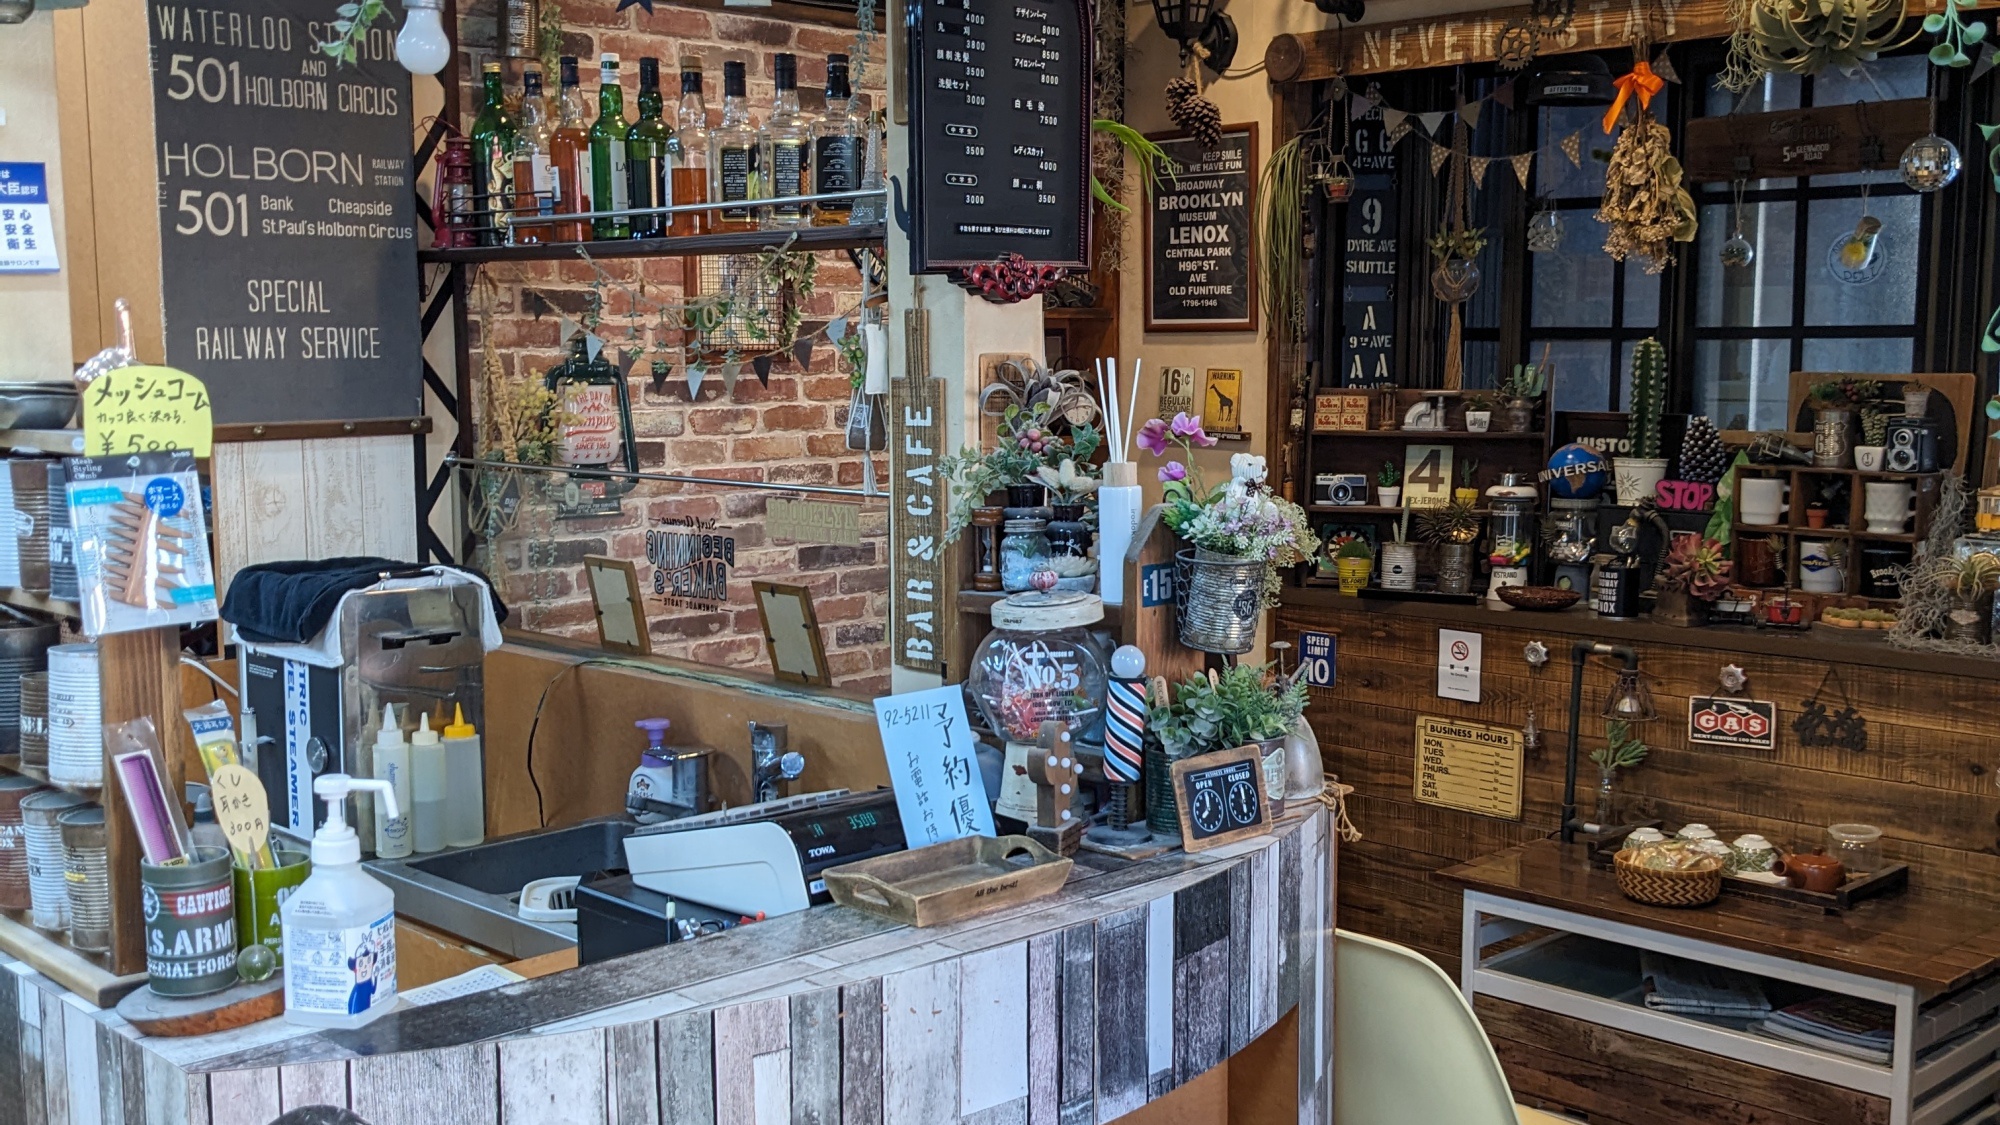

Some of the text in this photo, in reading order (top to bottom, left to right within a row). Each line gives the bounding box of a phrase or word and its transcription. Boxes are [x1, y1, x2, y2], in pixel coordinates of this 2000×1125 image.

[965, 13, 985, 25] 4000
[157, 4, 291, 52] WATERLOO
[1042, 25, 1060, 36] 8000
[966, 40, 985, 51] 3800
[1042, 50, 1060, 61] 8500
[301, 59, 327, 77] AND
[965, 66, 985, 77] 3500
[167, 54, 240, 105] 501
[245, 76, 328, 111] HOLBORN
[338, 83, 398, 115] CIRCUS
[1041, 74, 1059, 85] 8000
[966, 95, 985, 105] 3000
[1040, 115, 1058, 125] 7500
[965, 146, 985, 156] 3500
[1796, 143, 1830, 154] GLENWOOD
[1202, 152, 1220, 162] KEEP
[1221, 149, 1242, 160] SMILE
[1803, 152, 1823, 161] ROAD
[163, 141, 405, 187] HOLBORN RAILWAY STATION
[1039, 161, 1057, 172] 4000
[1189, 160, 1242, 172] WE HAVE FUN
[1371, 156, 1395, 169] AVE
[1175, 179, 1224, 191] BROADWAY
[965, 194, 985, 205] 3000
[1038, 194, 1056, 204] 3500
[1158, 191, 1244, 210] BROOKLYN
[2, 208, 32, 221] 安心
[176, 189, 248, 237] 501
[261, 195, 294, 212] Bank
[328, 199, 393, 218] Cheapside
[1178, 211, 1217, 222] MUSEUM
[1361, 198, 1382, 234] 9
[4, 223, 35, 236] 安全
[317, 221, 366, 238] Holborn
[368, 224, 413, 239] Circus
[1169, 224, 1229, 245] LENOX
[6, 238, 37, 251] 衛生
[1347, 239, 1396, 252] DYRE AVE
[1165, 247, 1232, 258] CENTRAL PARK
[1346, 260, 1396, 274] SHUTTLE
[1189, 273, 1207, 283] AVE
[247, 279, 330, 315] SPECIAL
[1168, 285, 1233, 296] OLD FUNITURE
[1362, 305, 1377, 330] A
[196, 327, 381, 360] RAILWAY SERVICE
[1369, 335, 1392, 348] AVE
[1349, 353, 1389, 379] A A
[1211, 371, 1236, 380] WARNING
[94, 375, 210, 411] メッシュコーム
[590, 390, 603, 401] DAY
[1160, 396, 1191, 406] REGULAR
[73, 465, 102, 473] Styling
[1408, 448, 1445, 493] 4
[74, 472, 97, 480] Comb
[1655, 480, 1713, 511] STOP
[767, 499, 860, 530] BROOKLYN
[905, 405, 934, 661] BAR & CAFE
[1149, 568, 1173, 601] 15
[1306, 635, 1330, 647] SPEED
[1307, 645, 1329, 656] LIMIT
[1024, 663, 1080, 691] No.5
[1308, 658, 1330, 684] 10
[884, 703, 930, 728] 92-5211
[1699, 714, 1762, 731] GAS
[1430, 724, 1508, 745] BUSINESS HOURS
[1424, 738, 1444, 748] MON.
[1423, 747, 1445, 757] TUES.
[1423, 755, 1443, 765] WED.
[288, 708, 300, 827] STEAMER
[932, 702, 981, 836] 予約優
[1423, 764, 1450, 775] THURS.
[217, 773, 241, 789] くし
[1227, 771, 1250, 782] CLOSED
[1422, 772, 1436, 781] FRI.
[1195, 779, 1213, 790] OPEN
[1422, 781, 1437, 790] SAT.
[1421, 789, 1439, 799] SUN.
[219, 793, 252, 813] 耳かき
[230, 818, 264, 835] 300円
[846, 812, 877, 830] 3500
[808, 845, 836, 858] TOWA
[974, 880, 1019, 898] All the best!
[177, 885, 231, 916] CAUTION
